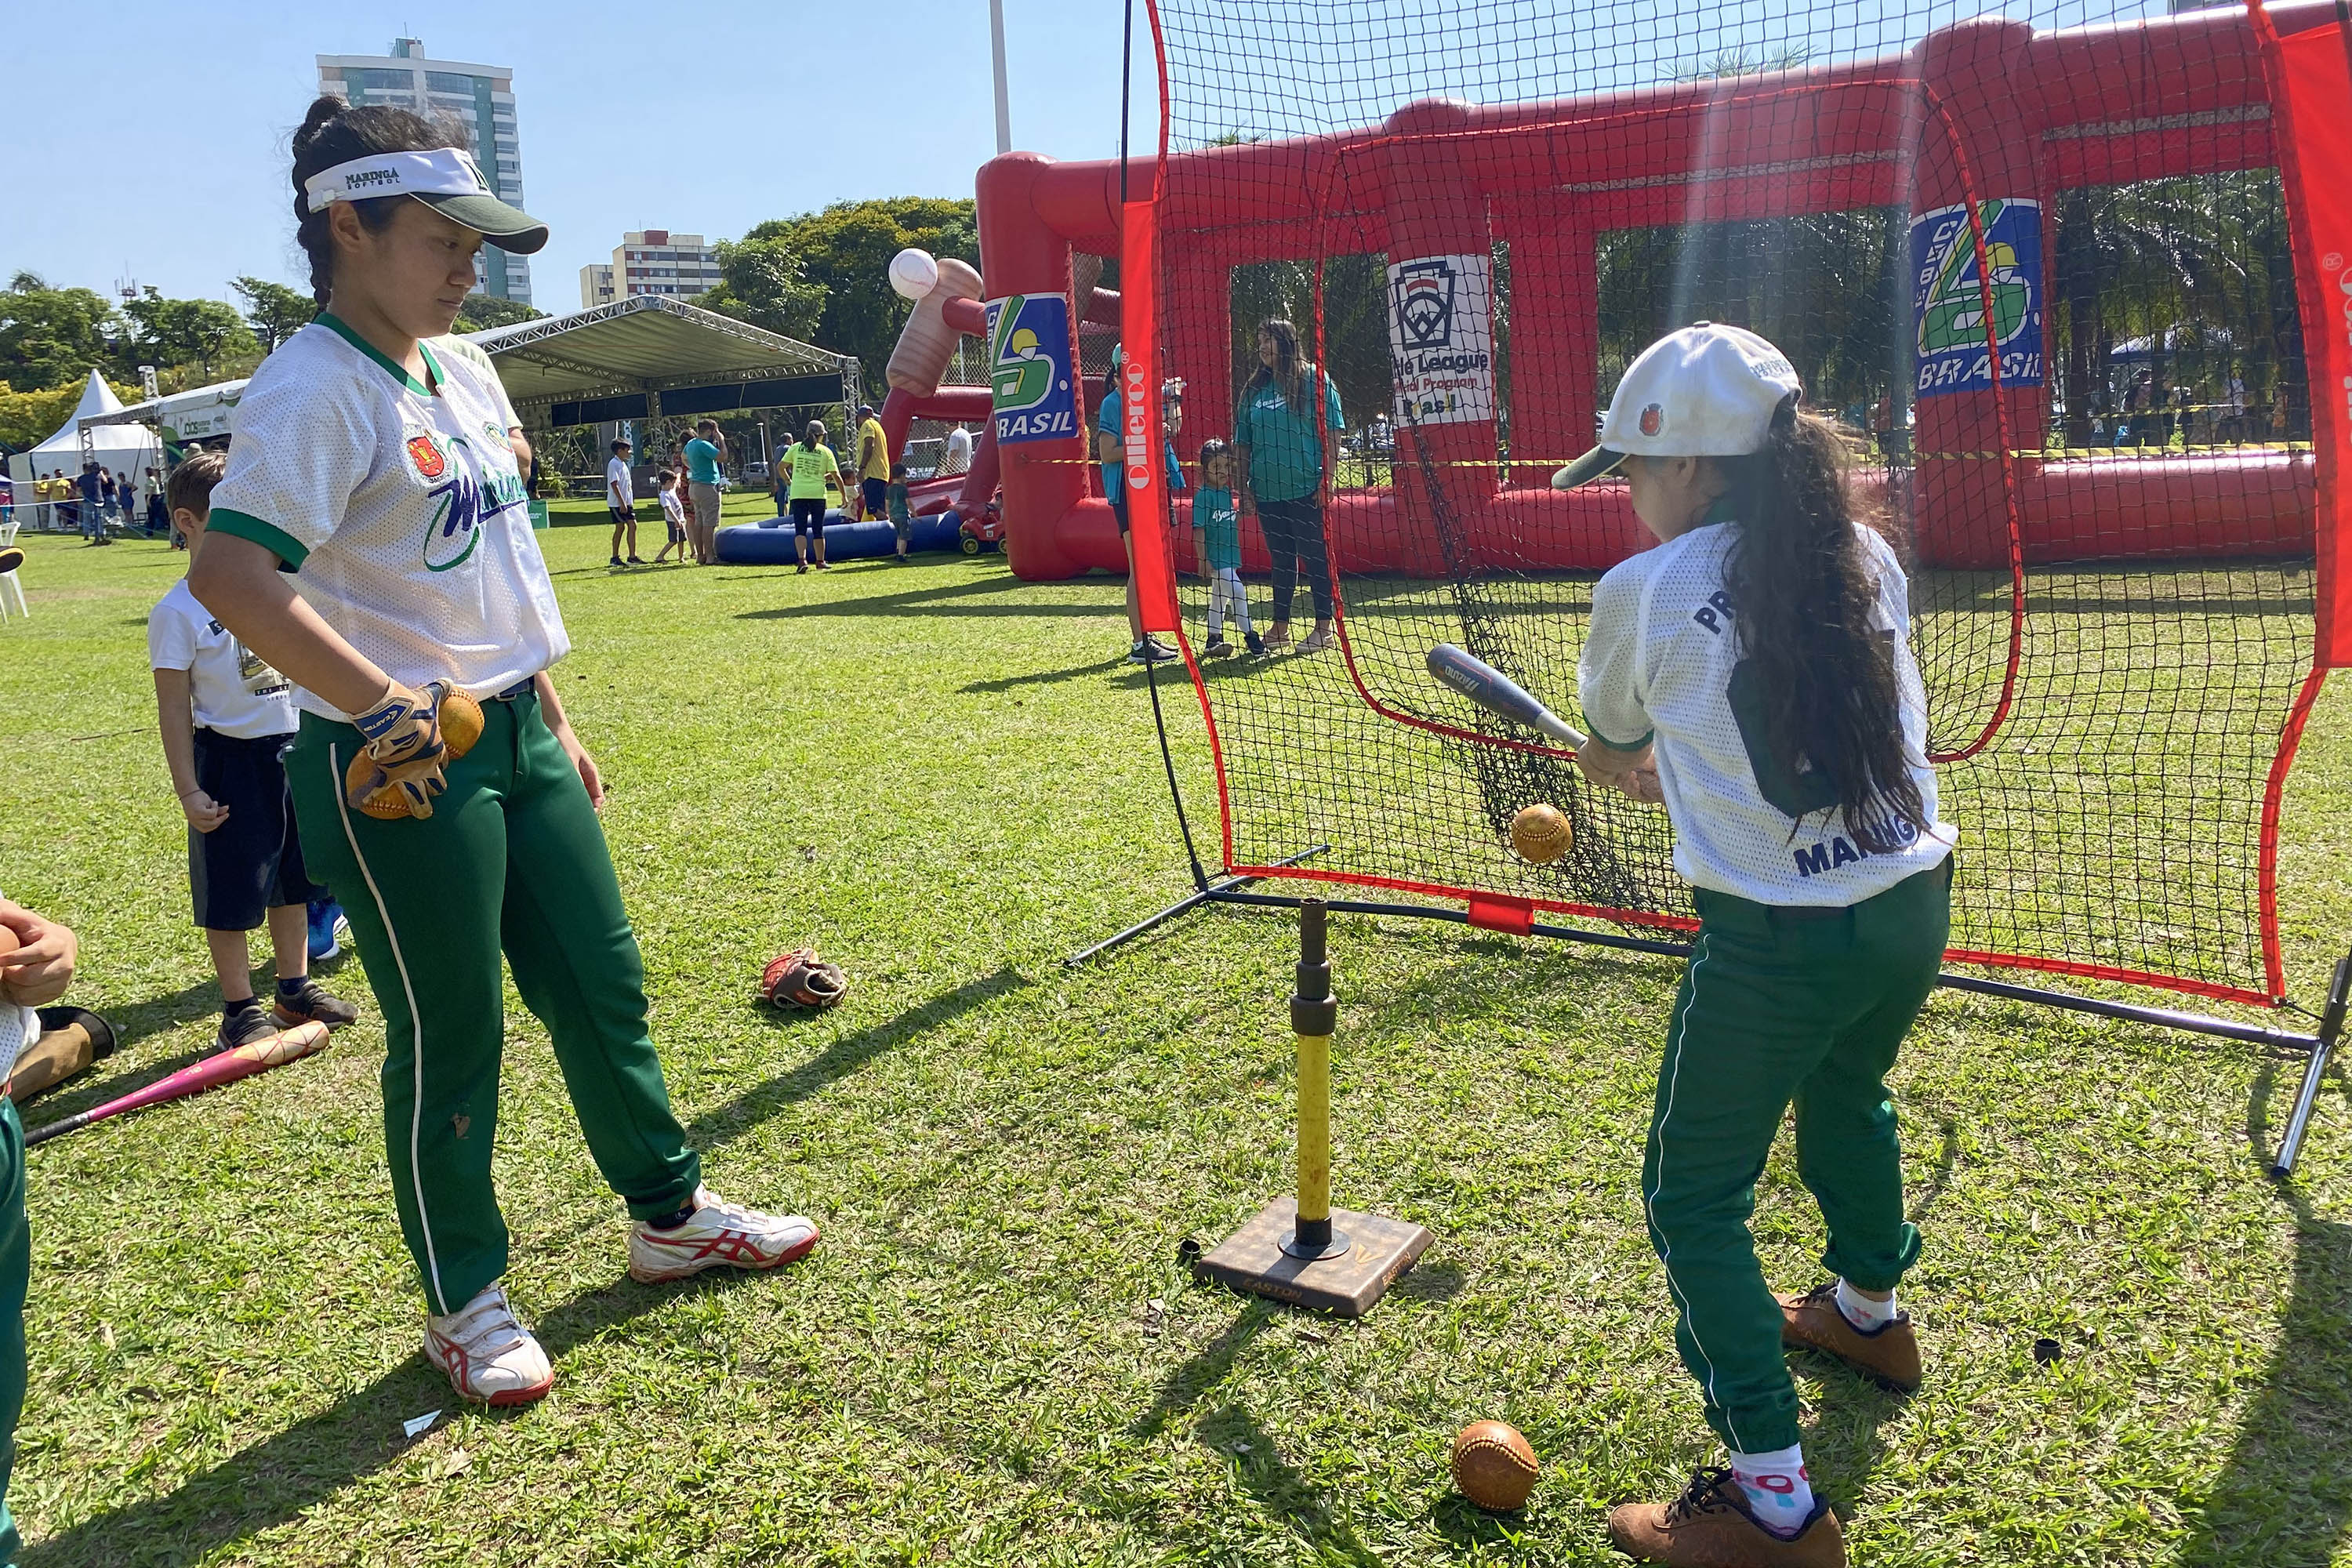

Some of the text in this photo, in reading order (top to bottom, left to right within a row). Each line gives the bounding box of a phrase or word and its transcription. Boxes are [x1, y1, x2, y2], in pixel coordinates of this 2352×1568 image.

[347, 178, 401, 190] SOFTBOL
[1418, 354, 1488, 374] League
[1918, 353, 2042, 390] BRASIL
[1423, 377, 1477, 391] Program
[996, 412, 1073, 441] RASIL
[363, 713, 392, 732] EASTON
[1381, 1250, 1412, 1287] EASTON
